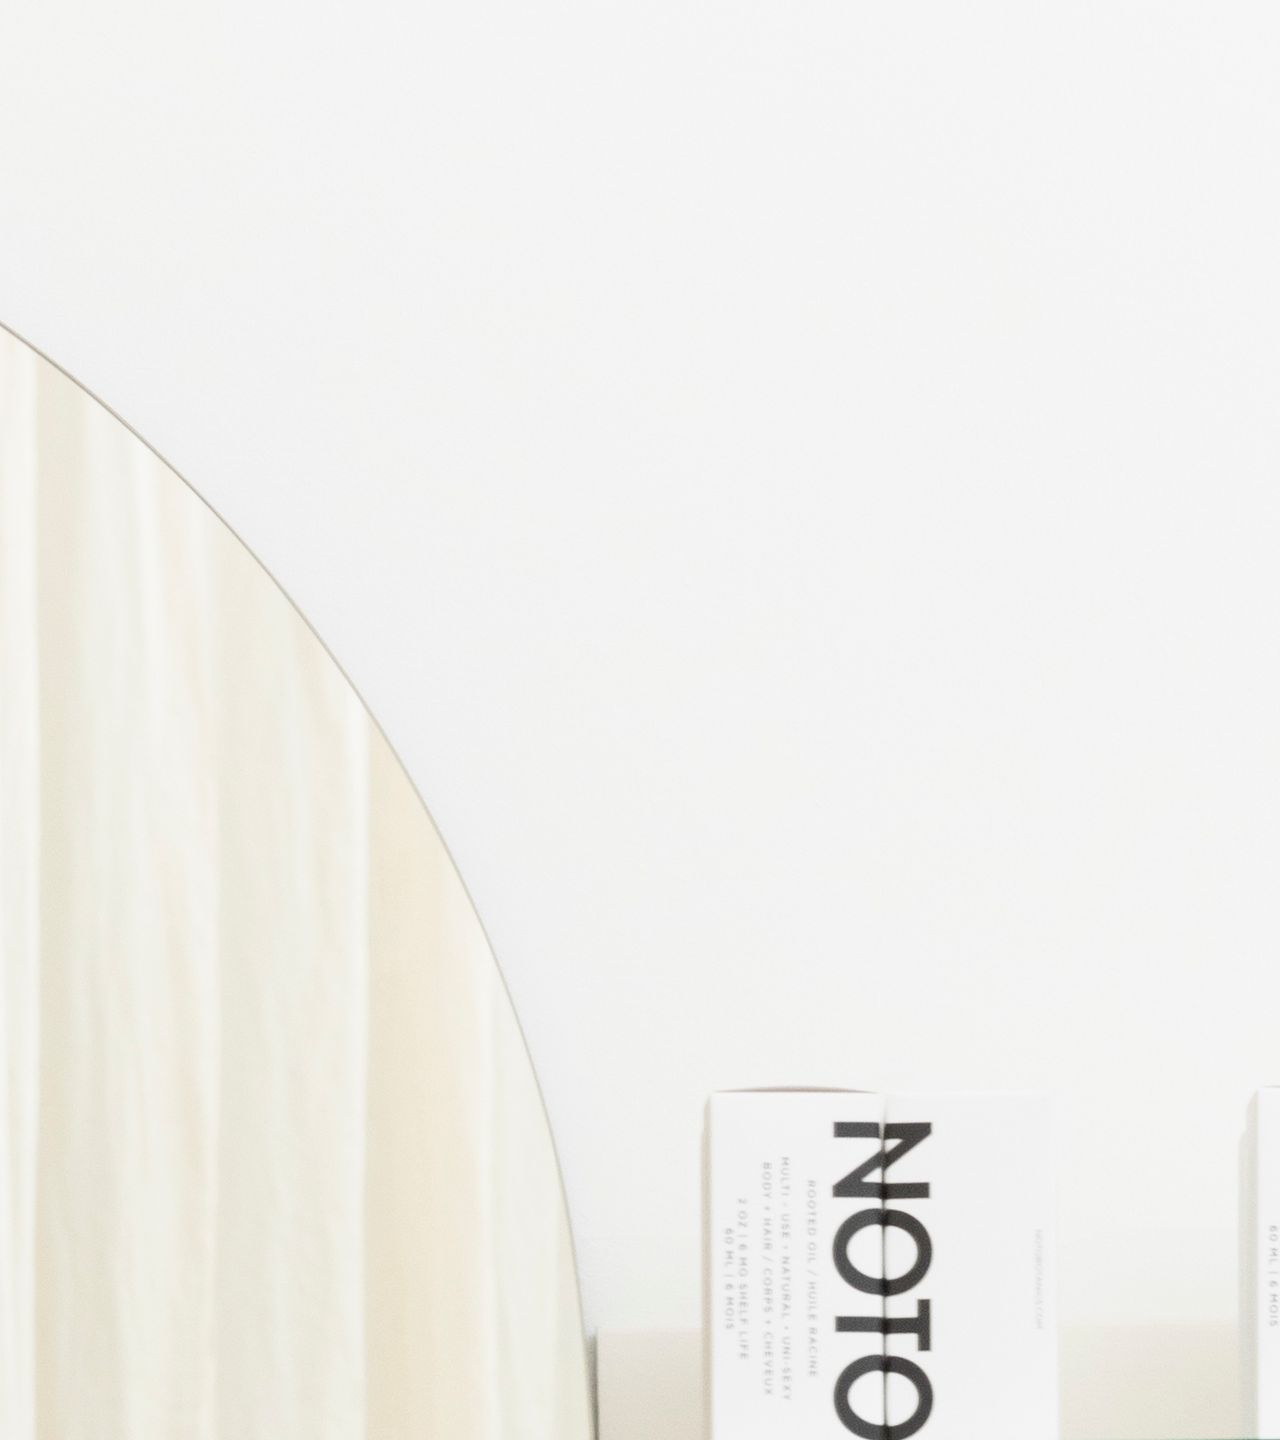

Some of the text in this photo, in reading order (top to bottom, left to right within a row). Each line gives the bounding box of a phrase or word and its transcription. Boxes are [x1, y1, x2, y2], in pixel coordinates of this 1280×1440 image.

[737, 1210, 748, 1228] OZ
[1269, 1225, 1278, 1242] 60
[725, 1227, 734, 1245] 60
[725, 1250, 734, 1267] ML
[738, 1256, 748, 1277] MO
[1269, 1247, 1278, 1265] ML
[762, 1161, 774, 1395] BODY HAIR CORPS CHEVEUX
[780, 1156, 792, 1400] MULTI USE NATURAL UNI-SEXY
[807, 1179, 818, 1377] ROOTED OIL HUILE RACINE
[725, 1296, 734, 1330] MOIS
[738, 1283, 748, 1325] SHELF
[1269, 1293, 1278, 1327] MOIS
[739, 1331, 749, 1360] LIFE
